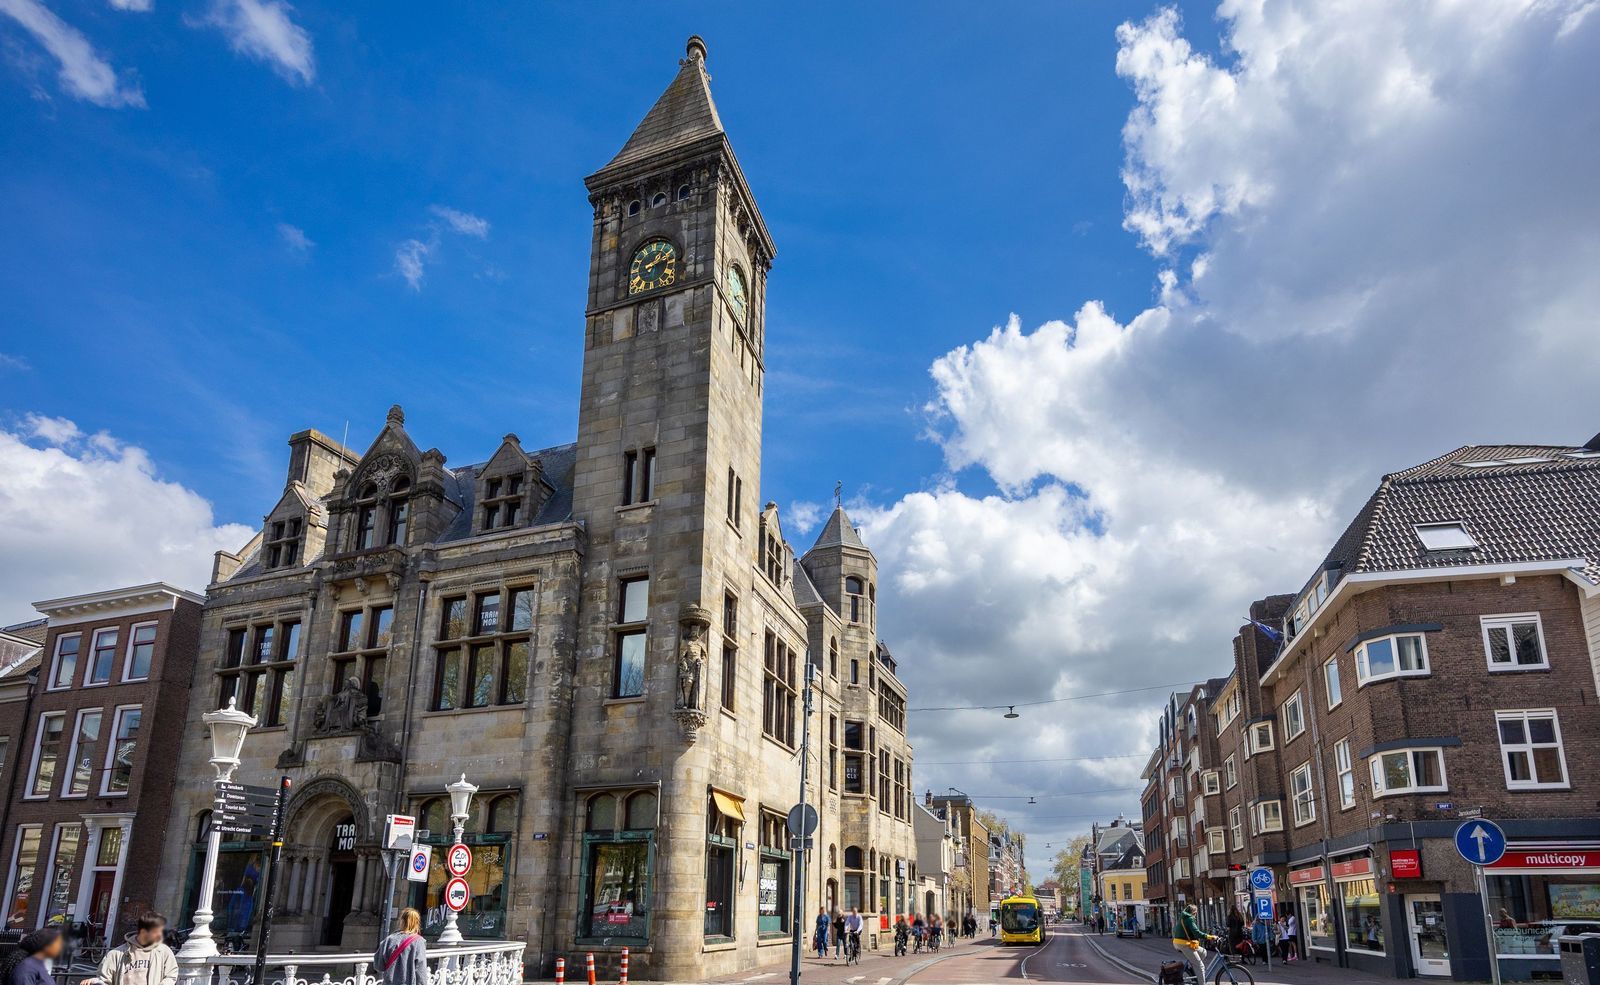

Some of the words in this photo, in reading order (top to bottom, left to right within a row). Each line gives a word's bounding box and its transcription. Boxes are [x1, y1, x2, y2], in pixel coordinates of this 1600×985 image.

[336, 824, 357, 838] TRA
[1526, 853, 1586, 866] multicopy
[1260, 900, 1268, 910] P
